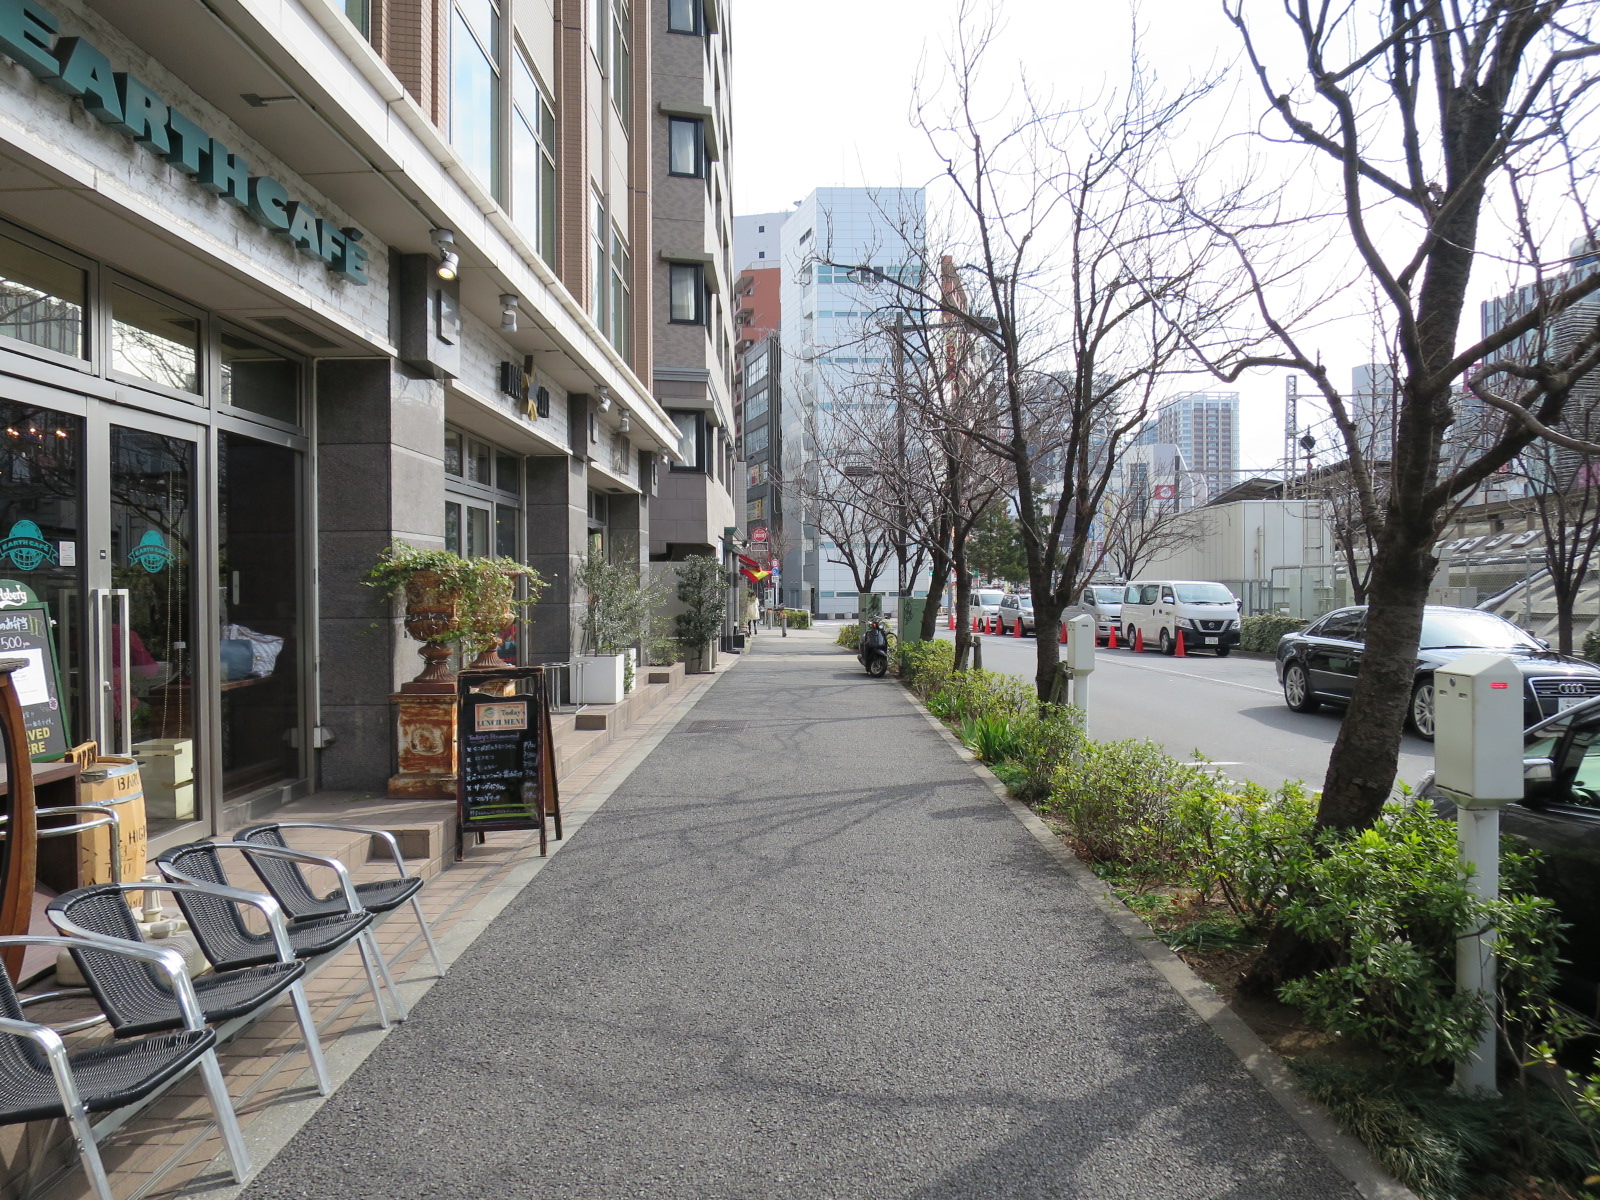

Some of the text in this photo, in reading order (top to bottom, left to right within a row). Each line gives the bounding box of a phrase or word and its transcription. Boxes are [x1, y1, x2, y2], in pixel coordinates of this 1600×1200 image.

[0, 0, 249, 206] EARTH
[2, 539, 27, 550] EARTH
[0, 584, 27, 604] lsberg
[1, 635, 22, 650] 500
[477, 718, 526, 727] LUNCH MENU
[26, 727, 51, 741] VED
[28, 741, 47, 755] RE
